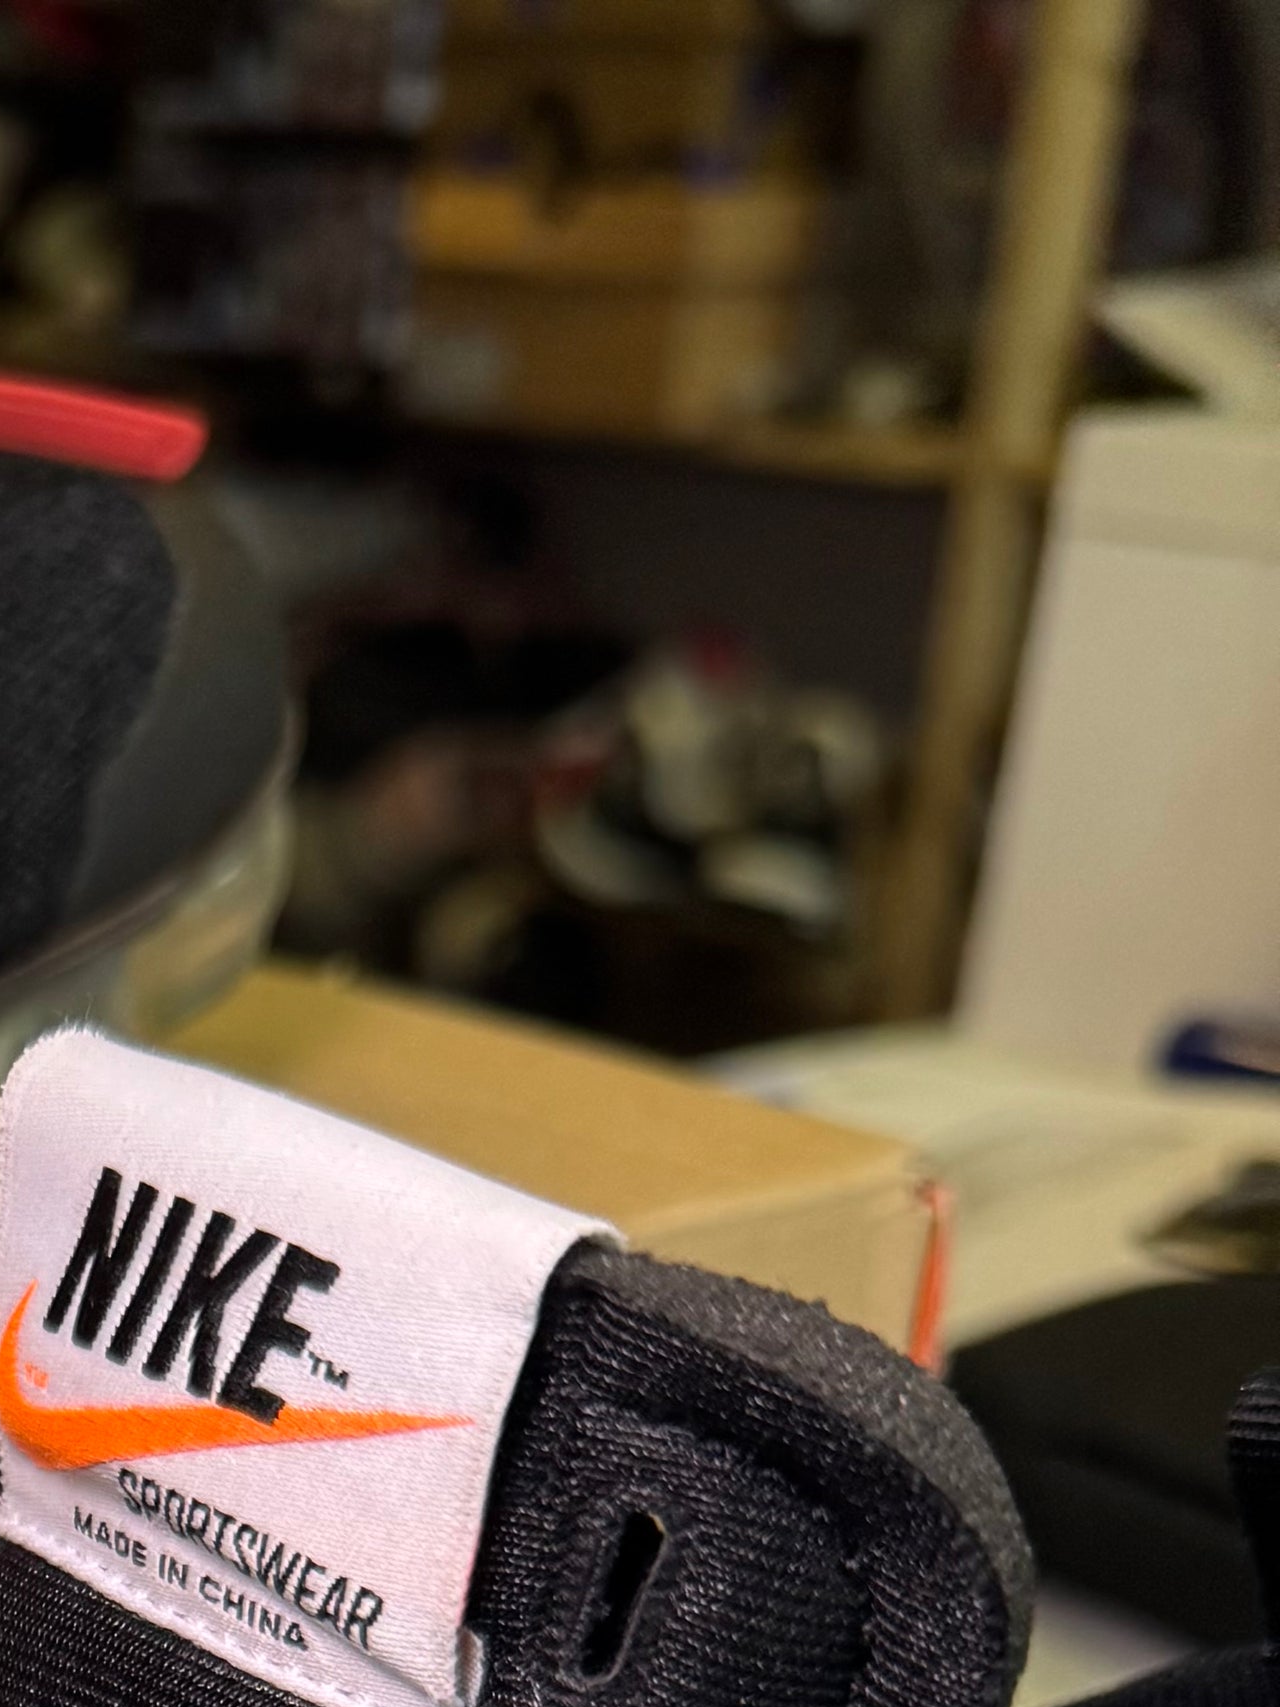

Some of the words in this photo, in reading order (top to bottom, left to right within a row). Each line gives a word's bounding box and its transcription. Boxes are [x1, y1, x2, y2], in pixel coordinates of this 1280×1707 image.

[74, 1505, 147, 1568] MADE
[158, 1553, 190, 1591] IN
[198, 1573, 309, 1652] CHINA
[117, 1466, 384, 1651] SPORTSWEAR
